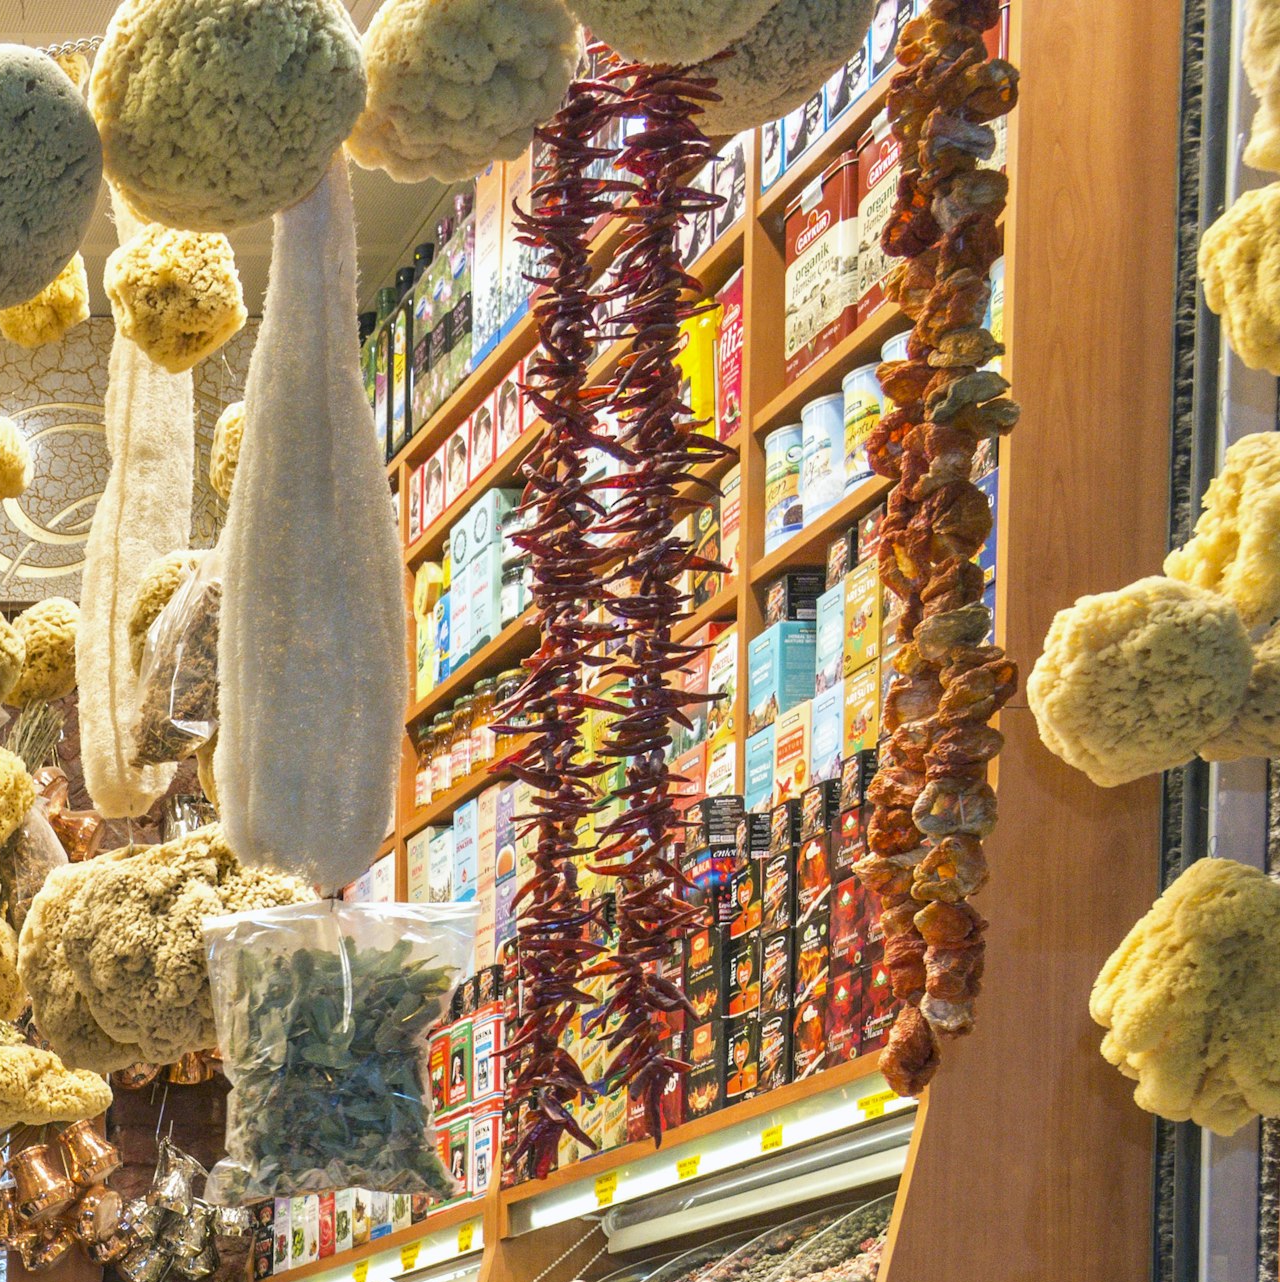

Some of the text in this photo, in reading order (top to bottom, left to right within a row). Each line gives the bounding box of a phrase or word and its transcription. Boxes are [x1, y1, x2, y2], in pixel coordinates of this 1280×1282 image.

[796, 216, 828, 250] ÇAYKUR
[795, 240, 829, 282] organik
[719, 327, 743, 363] filiz
